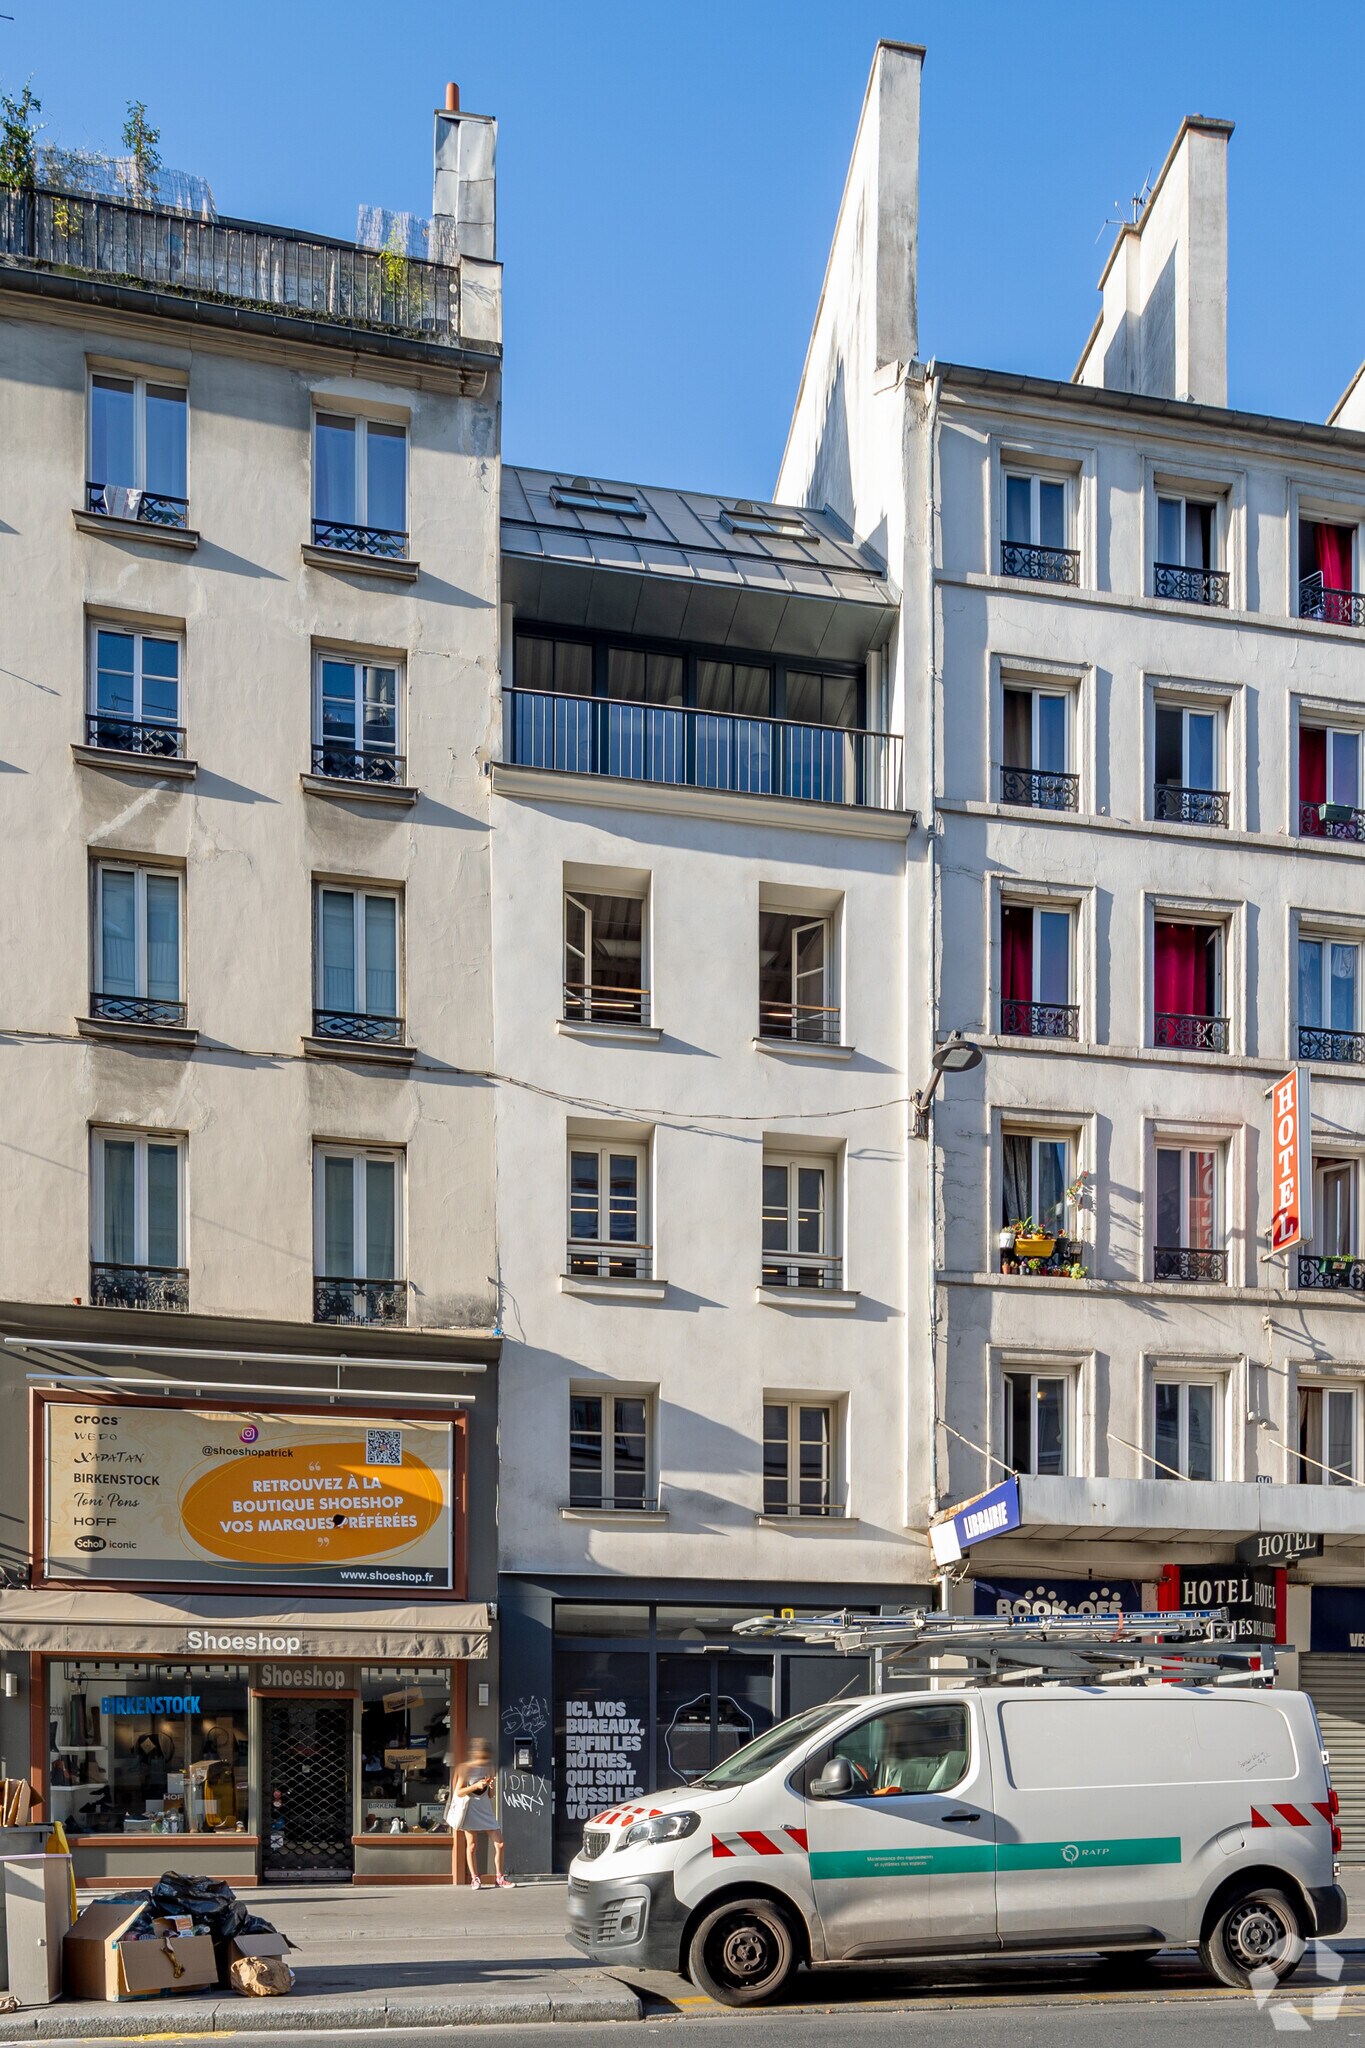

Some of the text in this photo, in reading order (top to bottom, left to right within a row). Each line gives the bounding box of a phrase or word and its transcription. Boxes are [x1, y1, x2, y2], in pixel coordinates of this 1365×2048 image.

[1277, 1080, 1294, 1243] HOTEL
[74, 1415, 118, 1425] crocs
[202, 1446, 294, 1458] @shoeshopatrick
[74, 1473, 160, 1486] BIRKENSTOCK
[252, 1474, 382, 1492] RETROUVEZ À LA
[74, 1492, 140, 1508] Toni Pons
[232, 1496, 404, 1513] BOUTIQUE SHOESHOP
[74, 1517, 117, 1526] HOFF
[220, 1519, 254, 1533] VOS
[258, 1517, 335, 1532] MARQUES
[963, 1501, 1009, 1539] LIBRAIRIE
[77, 1539, 137, 1549] Scholl iconic
[1257, 1533, 1316, 1557] HOTEL
[340, 1571, 434, 1583] www.shoeshop.fr
[1183, 1579, 1253, 1605] HOTEL
[1254, 1581, 1276, 1609] HOTEL
[188, 1631, 300, 1653] Shoeshop
[262, 1665, 345, 1689] Shoeshop
[101, 1696, 200, 1714] BIRKENSTOCK
[566, 1701, 626, 1718] ICI, VOS
[566, 1719, 645, 1736] BUREAUX,
[566, 1736, 642, 1751] ENFIN LES
[566, 1750, 632, 1769] NÔTRES,
[566, 1770, 636, 1787] QUI SONT
[566, 1787, 644, 1802] AUSSI LES
[566, 1801, 611, 1819] VÔTR
[1081, 1848, 1110, 1856] RATP
